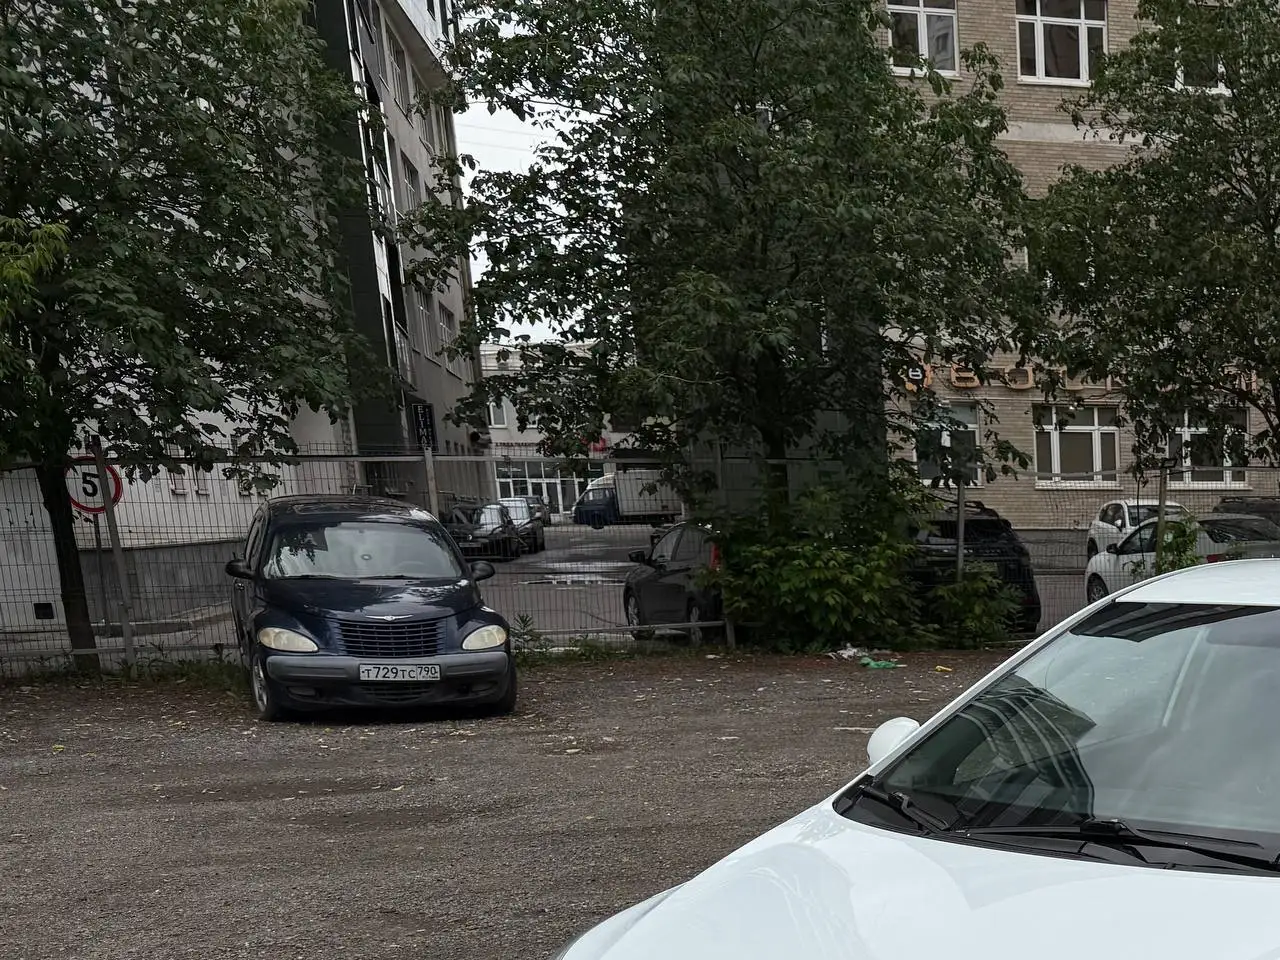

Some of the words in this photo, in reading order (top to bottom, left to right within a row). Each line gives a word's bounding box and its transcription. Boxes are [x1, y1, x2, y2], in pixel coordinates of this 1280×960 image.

[82, 472, 100, 497] 5
[364, 666, 416, 679] Т729ТС
[417, 666, 438, 676] 790
